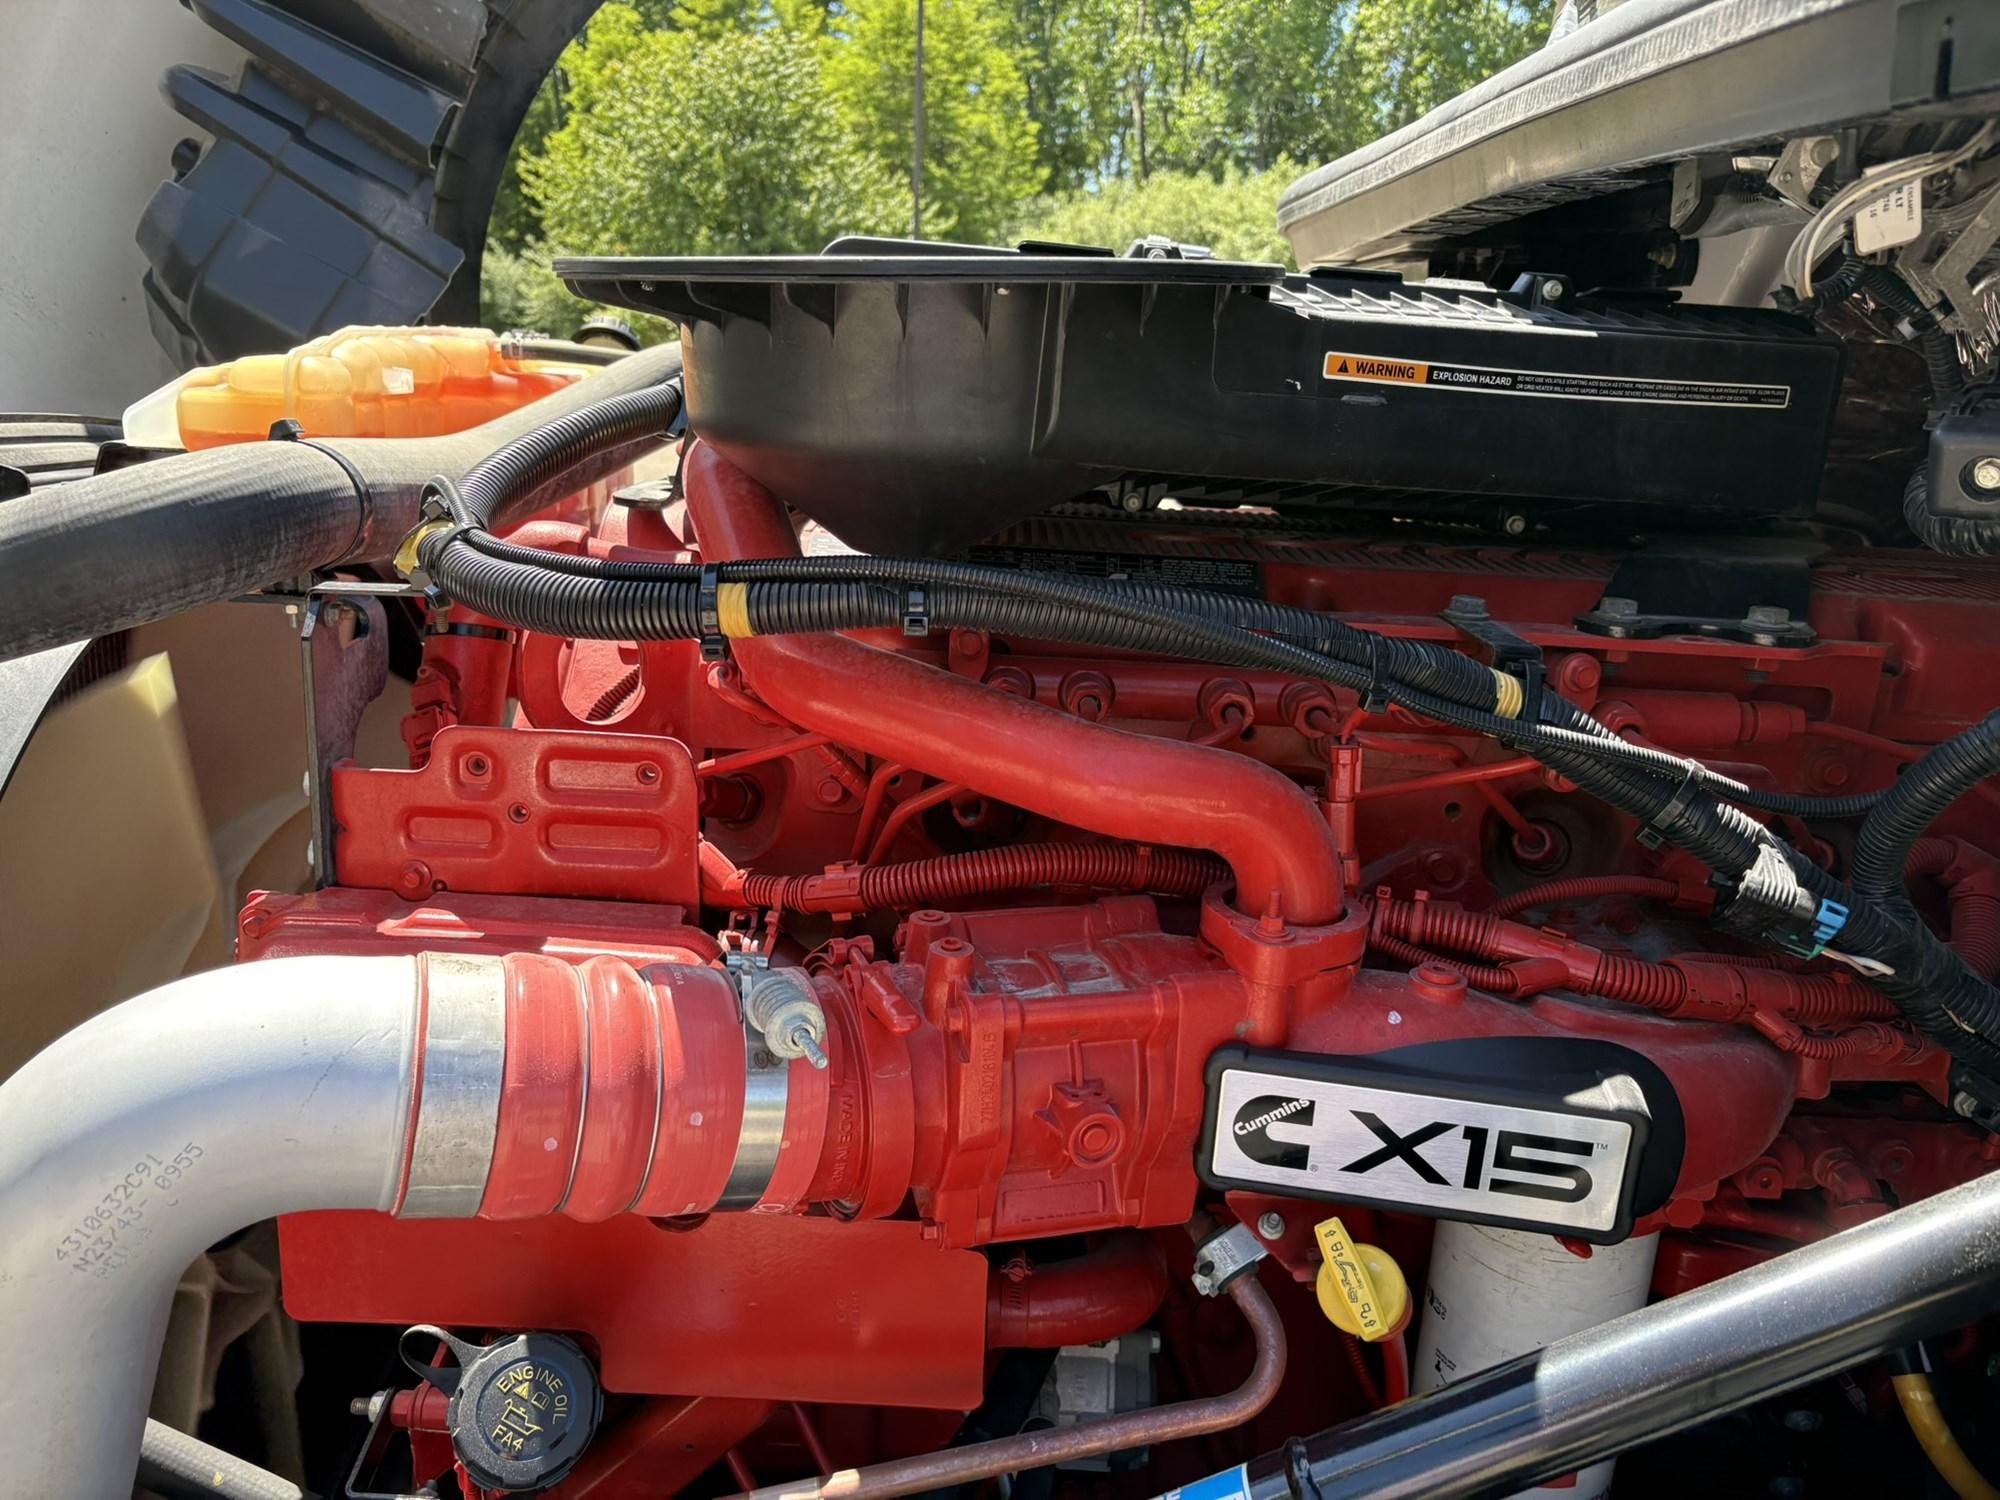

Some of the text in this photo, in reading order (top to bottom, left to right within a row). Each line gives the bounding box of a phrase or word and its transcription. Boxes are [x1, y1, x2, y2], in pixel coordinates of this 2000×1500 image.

[1356, 360, 1415, 379] WARNING
[1432, 370, 1512, 386] EXPLOSION HAZARD
[841, 1094, 853, 1144] MADE
[1234, 1098, 1311, 1135] Cummins
[154, 1142, 204, 1191] 0955
[833, 1145, 849, 1160] IN
[1338, 1109, 1594, 1203] X15
[57, 1153, 164, 1261] 4310632C91
[496, 1365, 568, 1425] ENGINE OIL
[491, 1424, 525, 1452] FA4
